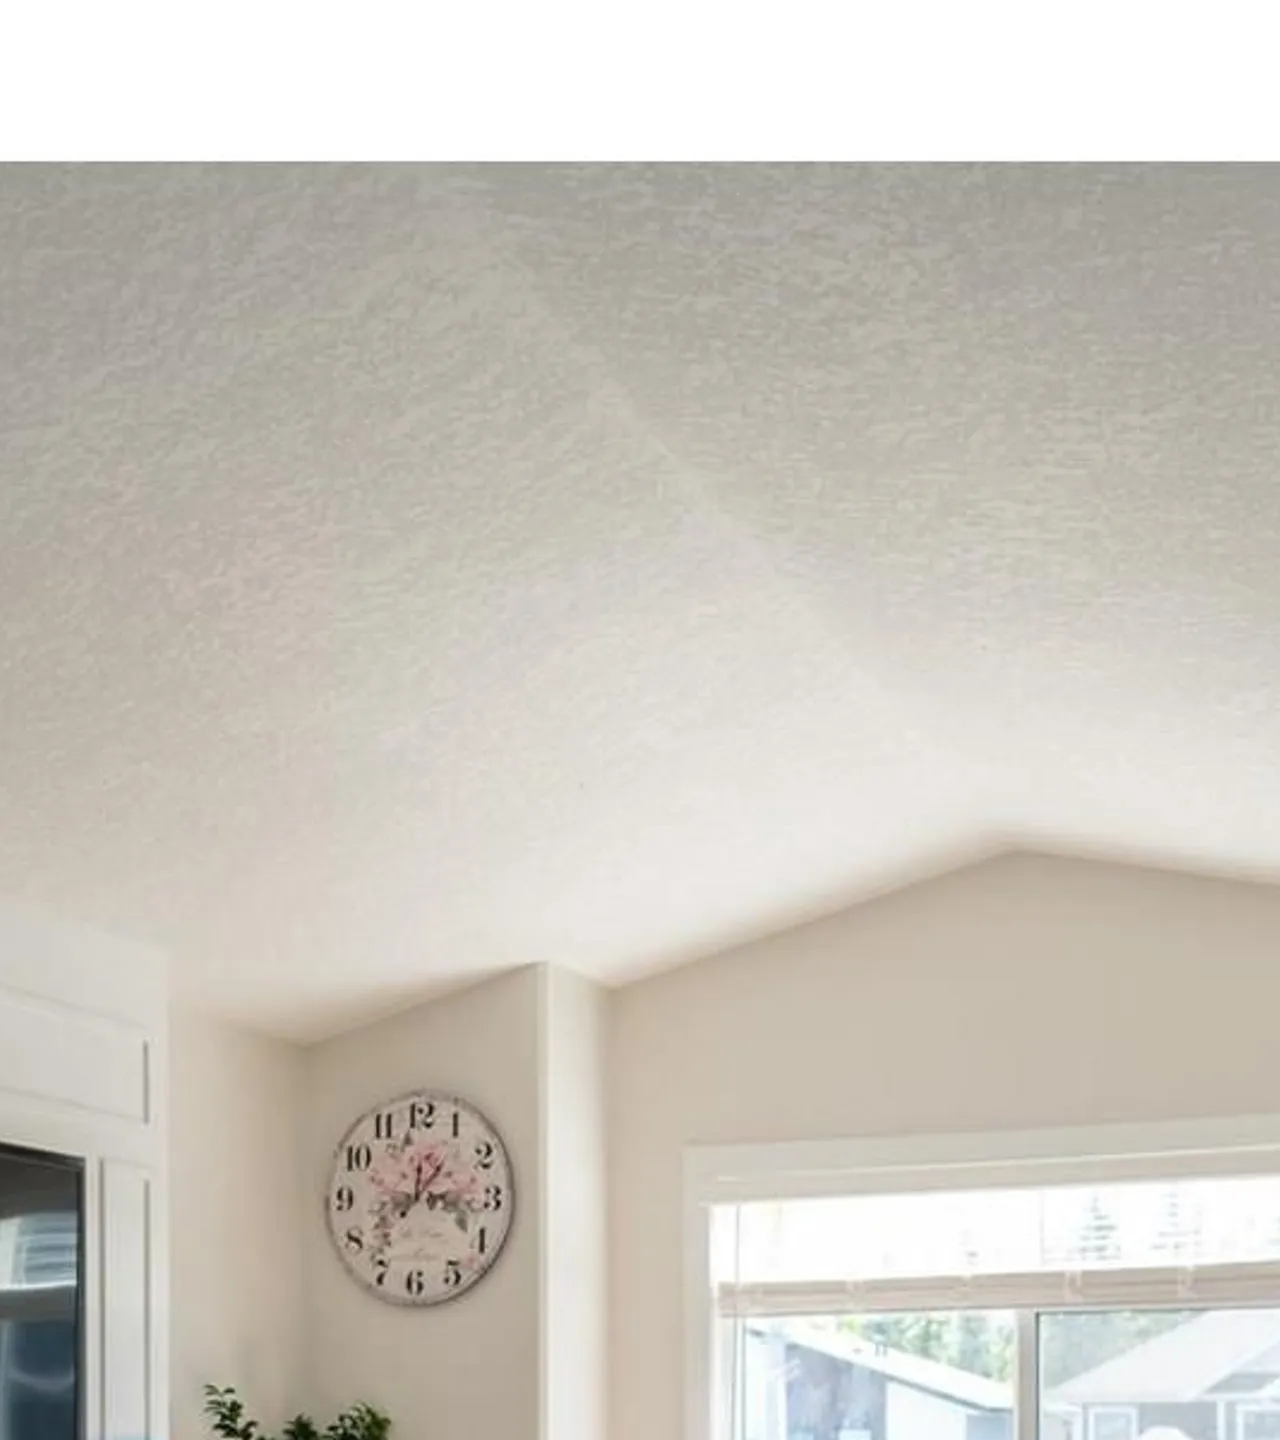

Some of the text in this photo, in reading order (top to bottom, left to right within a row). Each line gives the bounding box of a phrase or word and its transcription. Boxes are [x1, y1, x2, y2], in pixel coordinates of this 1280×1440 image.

[375, 1113, 392, 1139] 11
[410, 1102, 435, 1129] 12
[452, 1112, 459, 1138] 1
[347, 1144, 372, 1172] 10
[474, 1143, 493, 1170] 2
[336, 1186, 353, 1211] 9
[483, 1185, 502, 1211] 3
[345, 1227, 363, 1252] 8
[372, 1253, 390, 1286] 7
[406, 1270, 424, 1295] 6
[444, 1260, 462, 1286] 5
